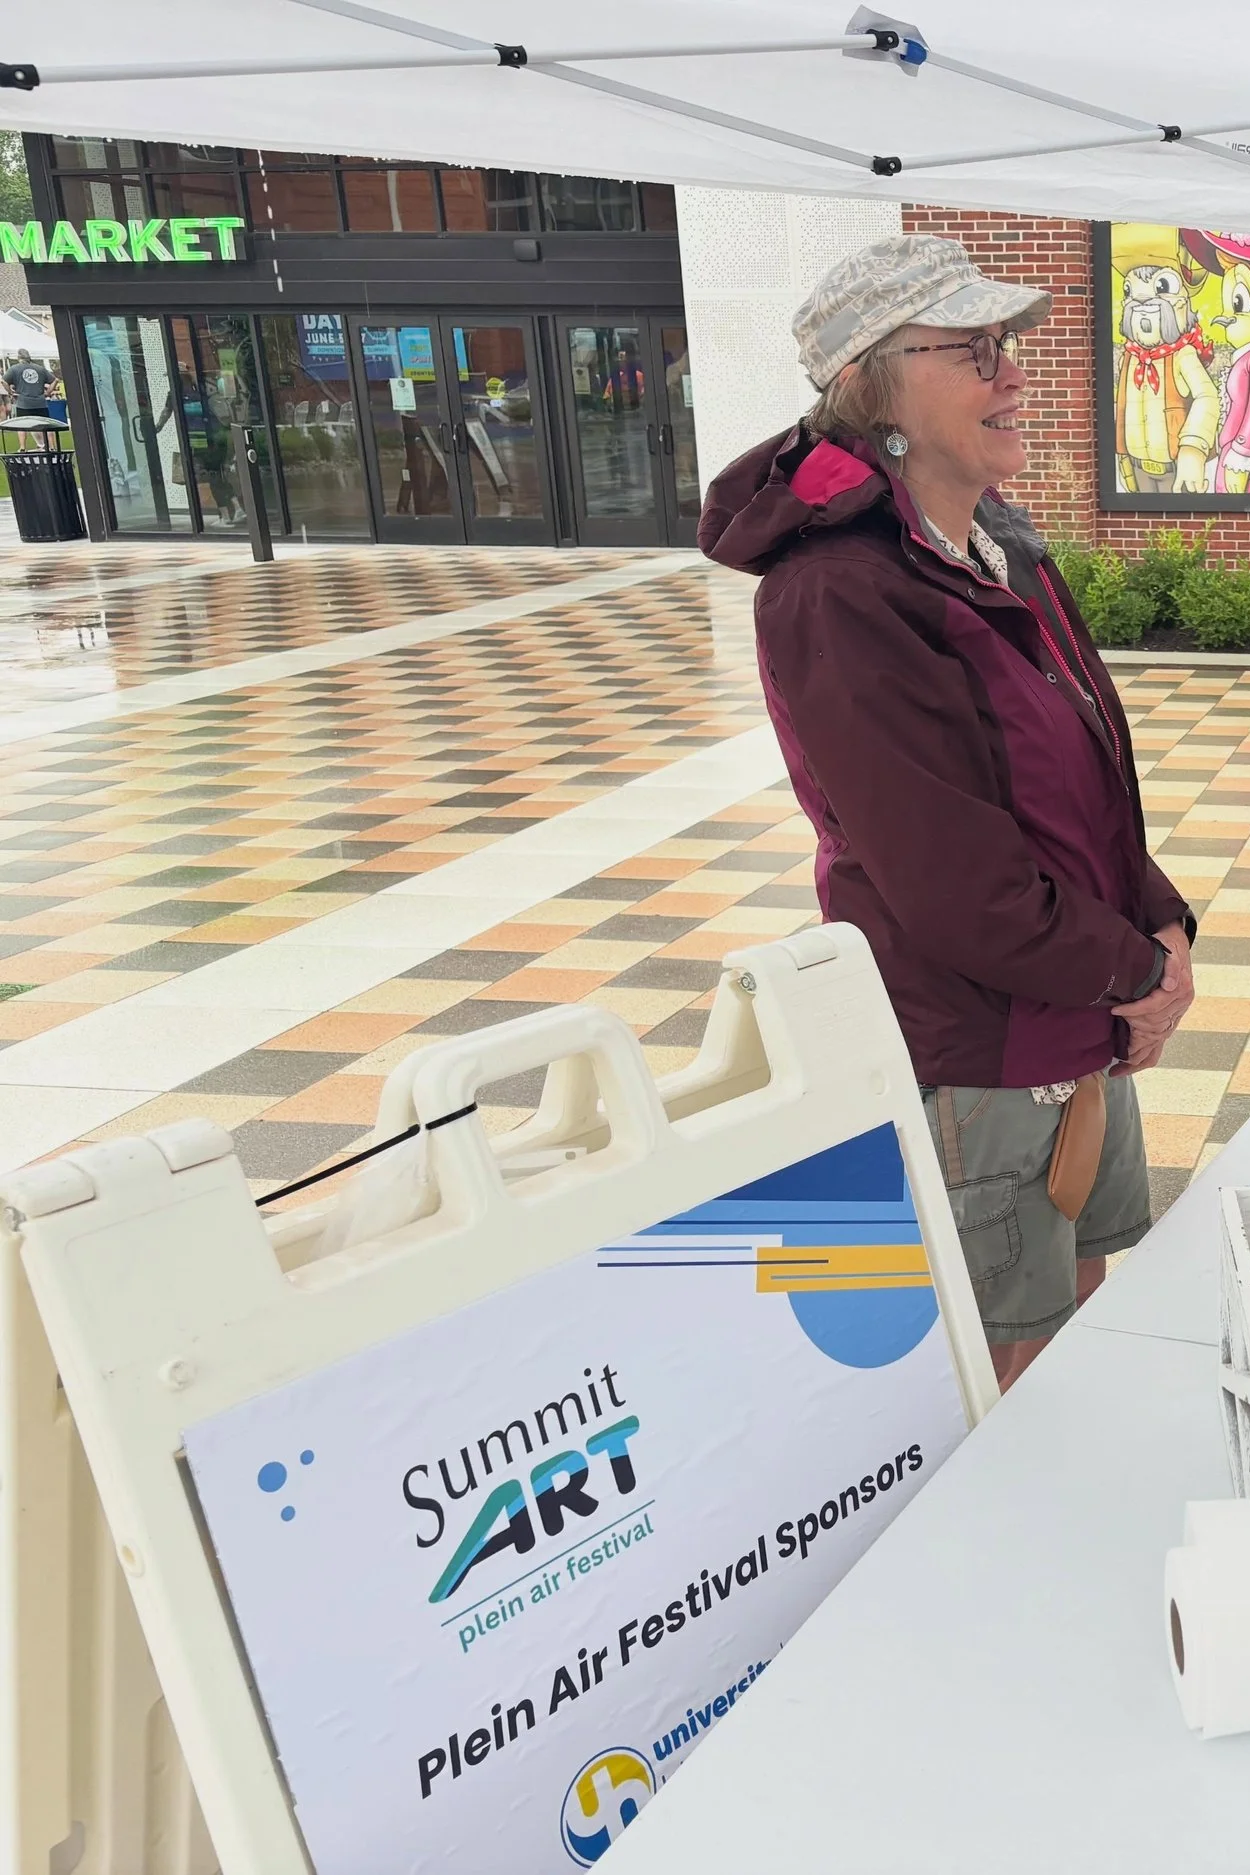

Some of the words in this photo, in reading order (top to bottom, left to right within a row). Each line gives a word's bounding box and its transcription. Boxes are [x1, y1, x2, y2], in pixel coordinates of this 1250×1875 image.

[0, 218, 245, 263] MARKET
[305, 332, 334, 344] JUNE
[402, 1363, 627, 1549] Summit
[428, 1414, 641, 1604] ART
[418, 1698, 536, 1800] Plein
[548, 1646, 609, 1716] Air
[618, 1535, 769, 1667] Festival
[775, 1443, 924, 1560] Sponsors
[458, 1596, 526, 1654] plein
[529, 1570, 561, 1605] air
[566, 1513, 655, 1582] festival
